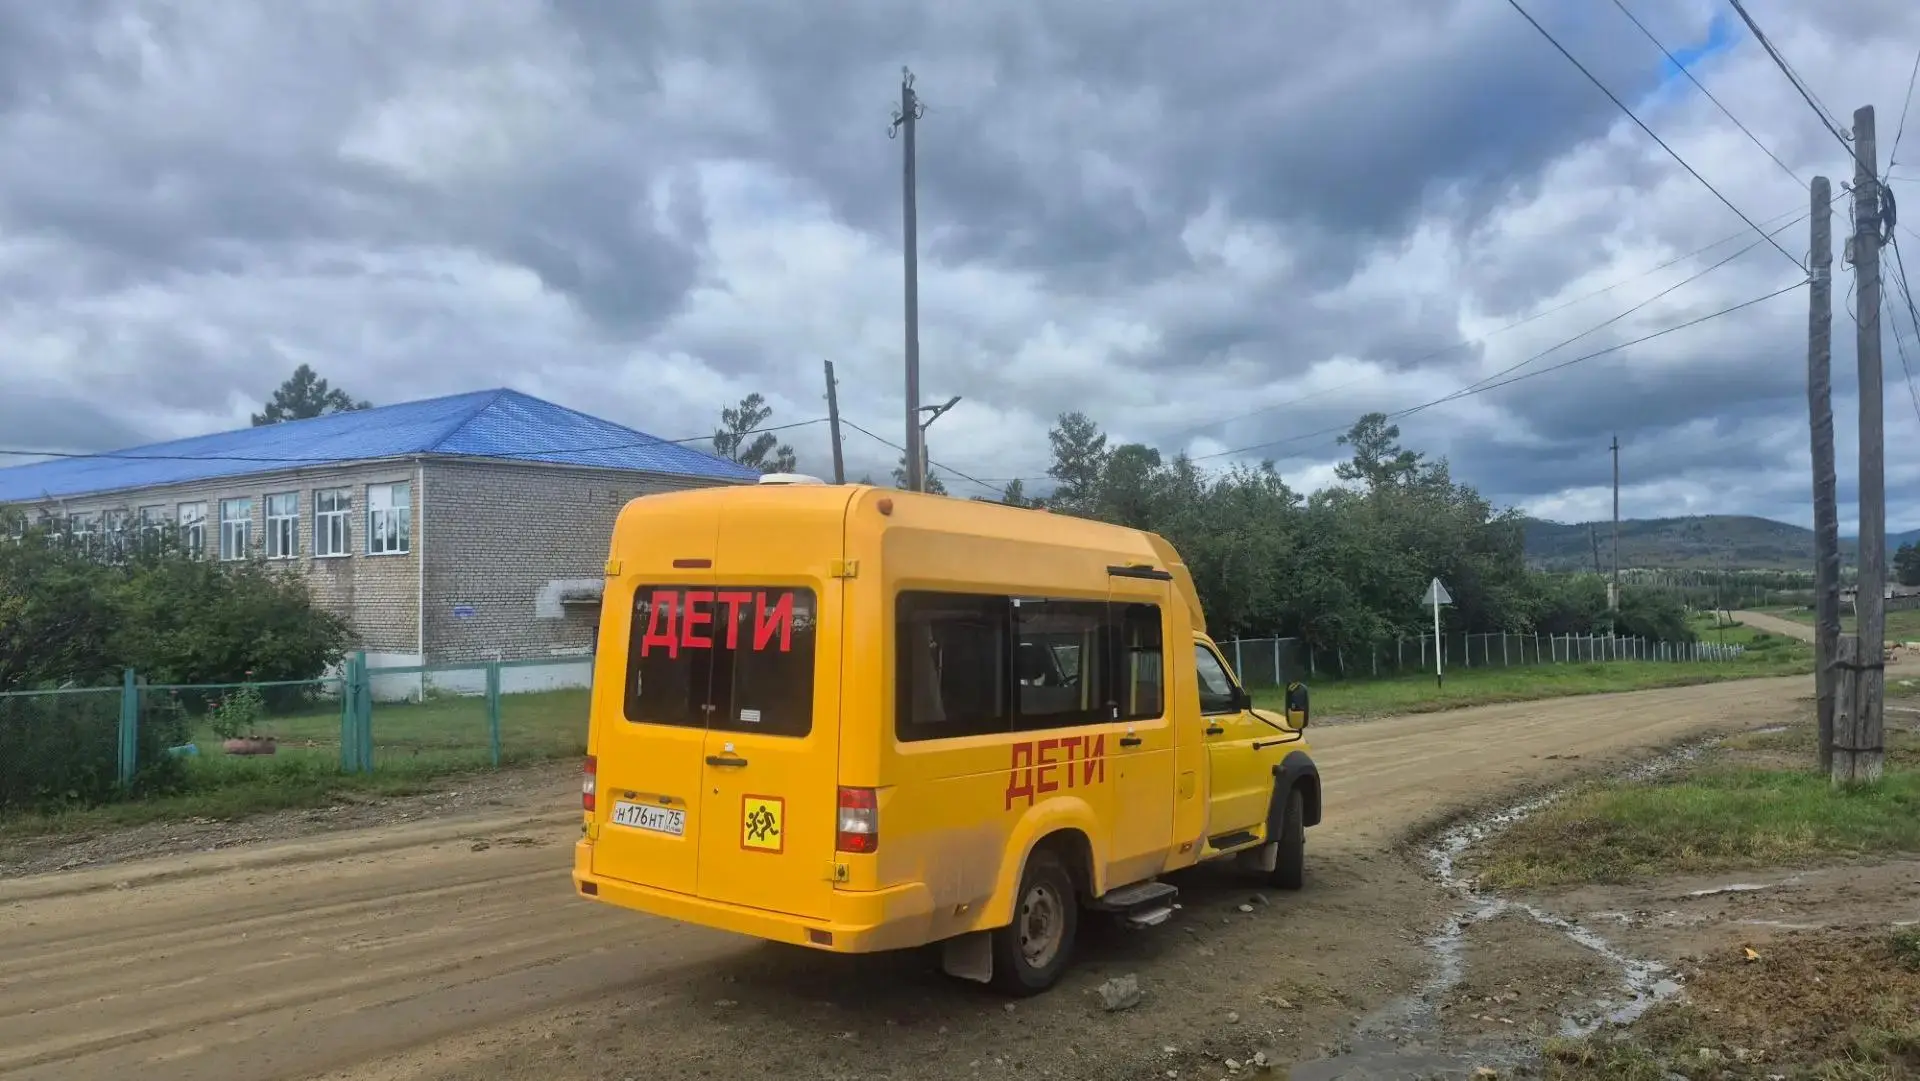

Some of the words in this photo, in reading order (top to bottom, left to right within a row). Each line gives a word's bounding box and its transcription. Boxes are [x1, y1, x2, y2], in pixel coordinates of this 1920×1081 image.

[641, 591, 794, 659] ДЕТИ
[1005, 734, 1105, 811] ДЕТИ
[668, 811, 681, 826] 75
